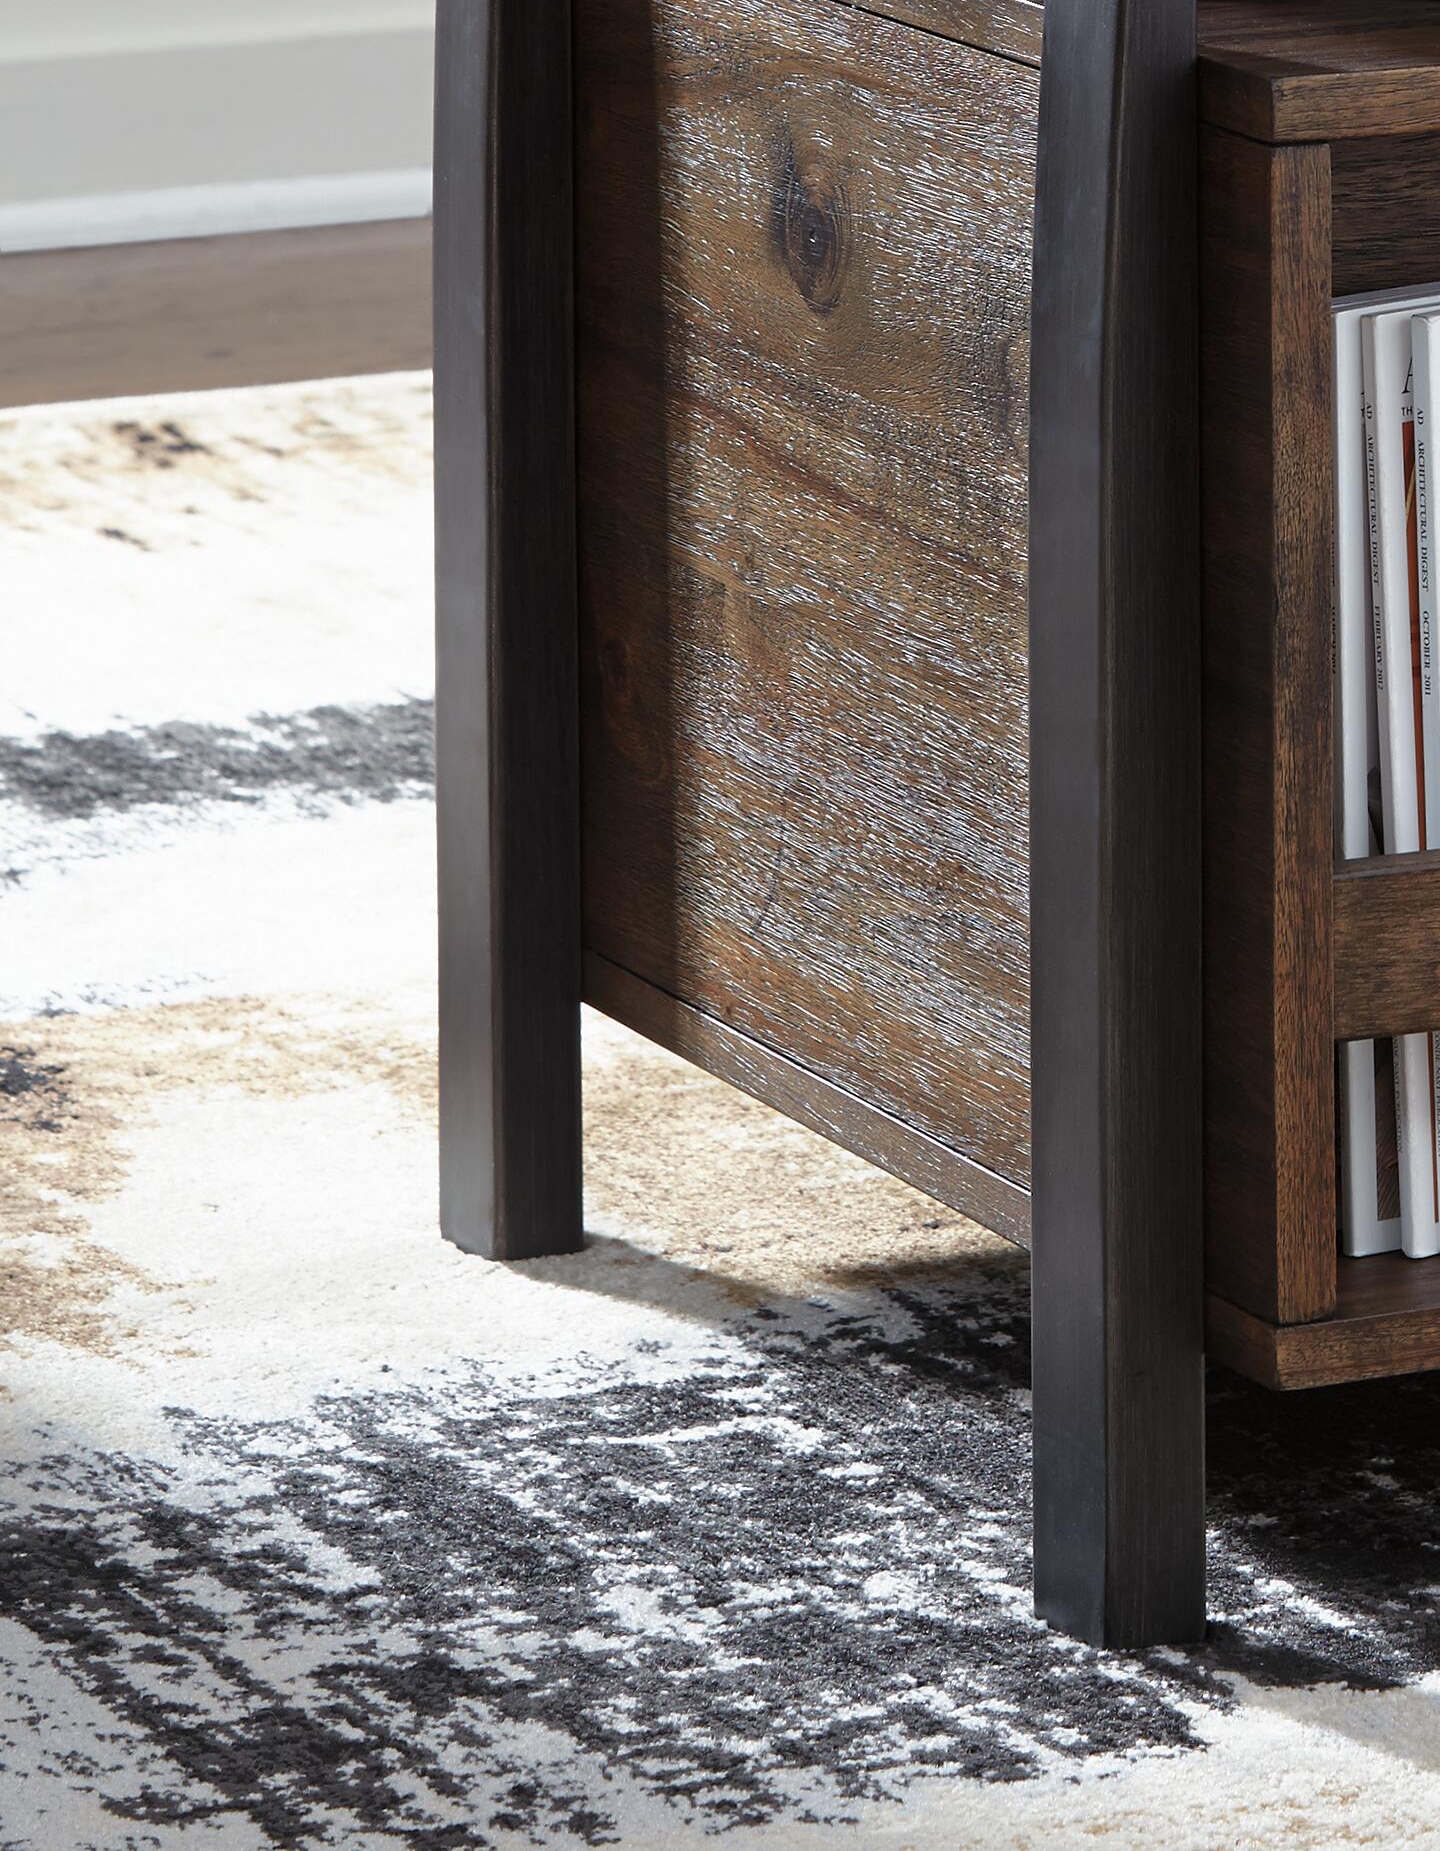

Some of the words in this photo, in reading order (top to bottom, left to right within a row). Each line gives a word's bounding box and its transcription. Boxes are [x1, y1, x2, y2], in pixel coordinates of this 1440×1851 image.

[1366, 402, 1373, 420] AD
[1416, 407, 1424, 425] AD
[1367, 434, 1378, 538] ARCHITECTURAL
[1417, 439, 1428, 542] ARCHITECTURAL
[1371, 541, 1380, 586] DIGEST
[1420, 546, 1429, 593] DIGEST
[1374, 605, 1383, 665] FEBRUARY
[1422, 610, 1431, 670] OCTOBER
[1424, 674, 1432, 696] 2011
